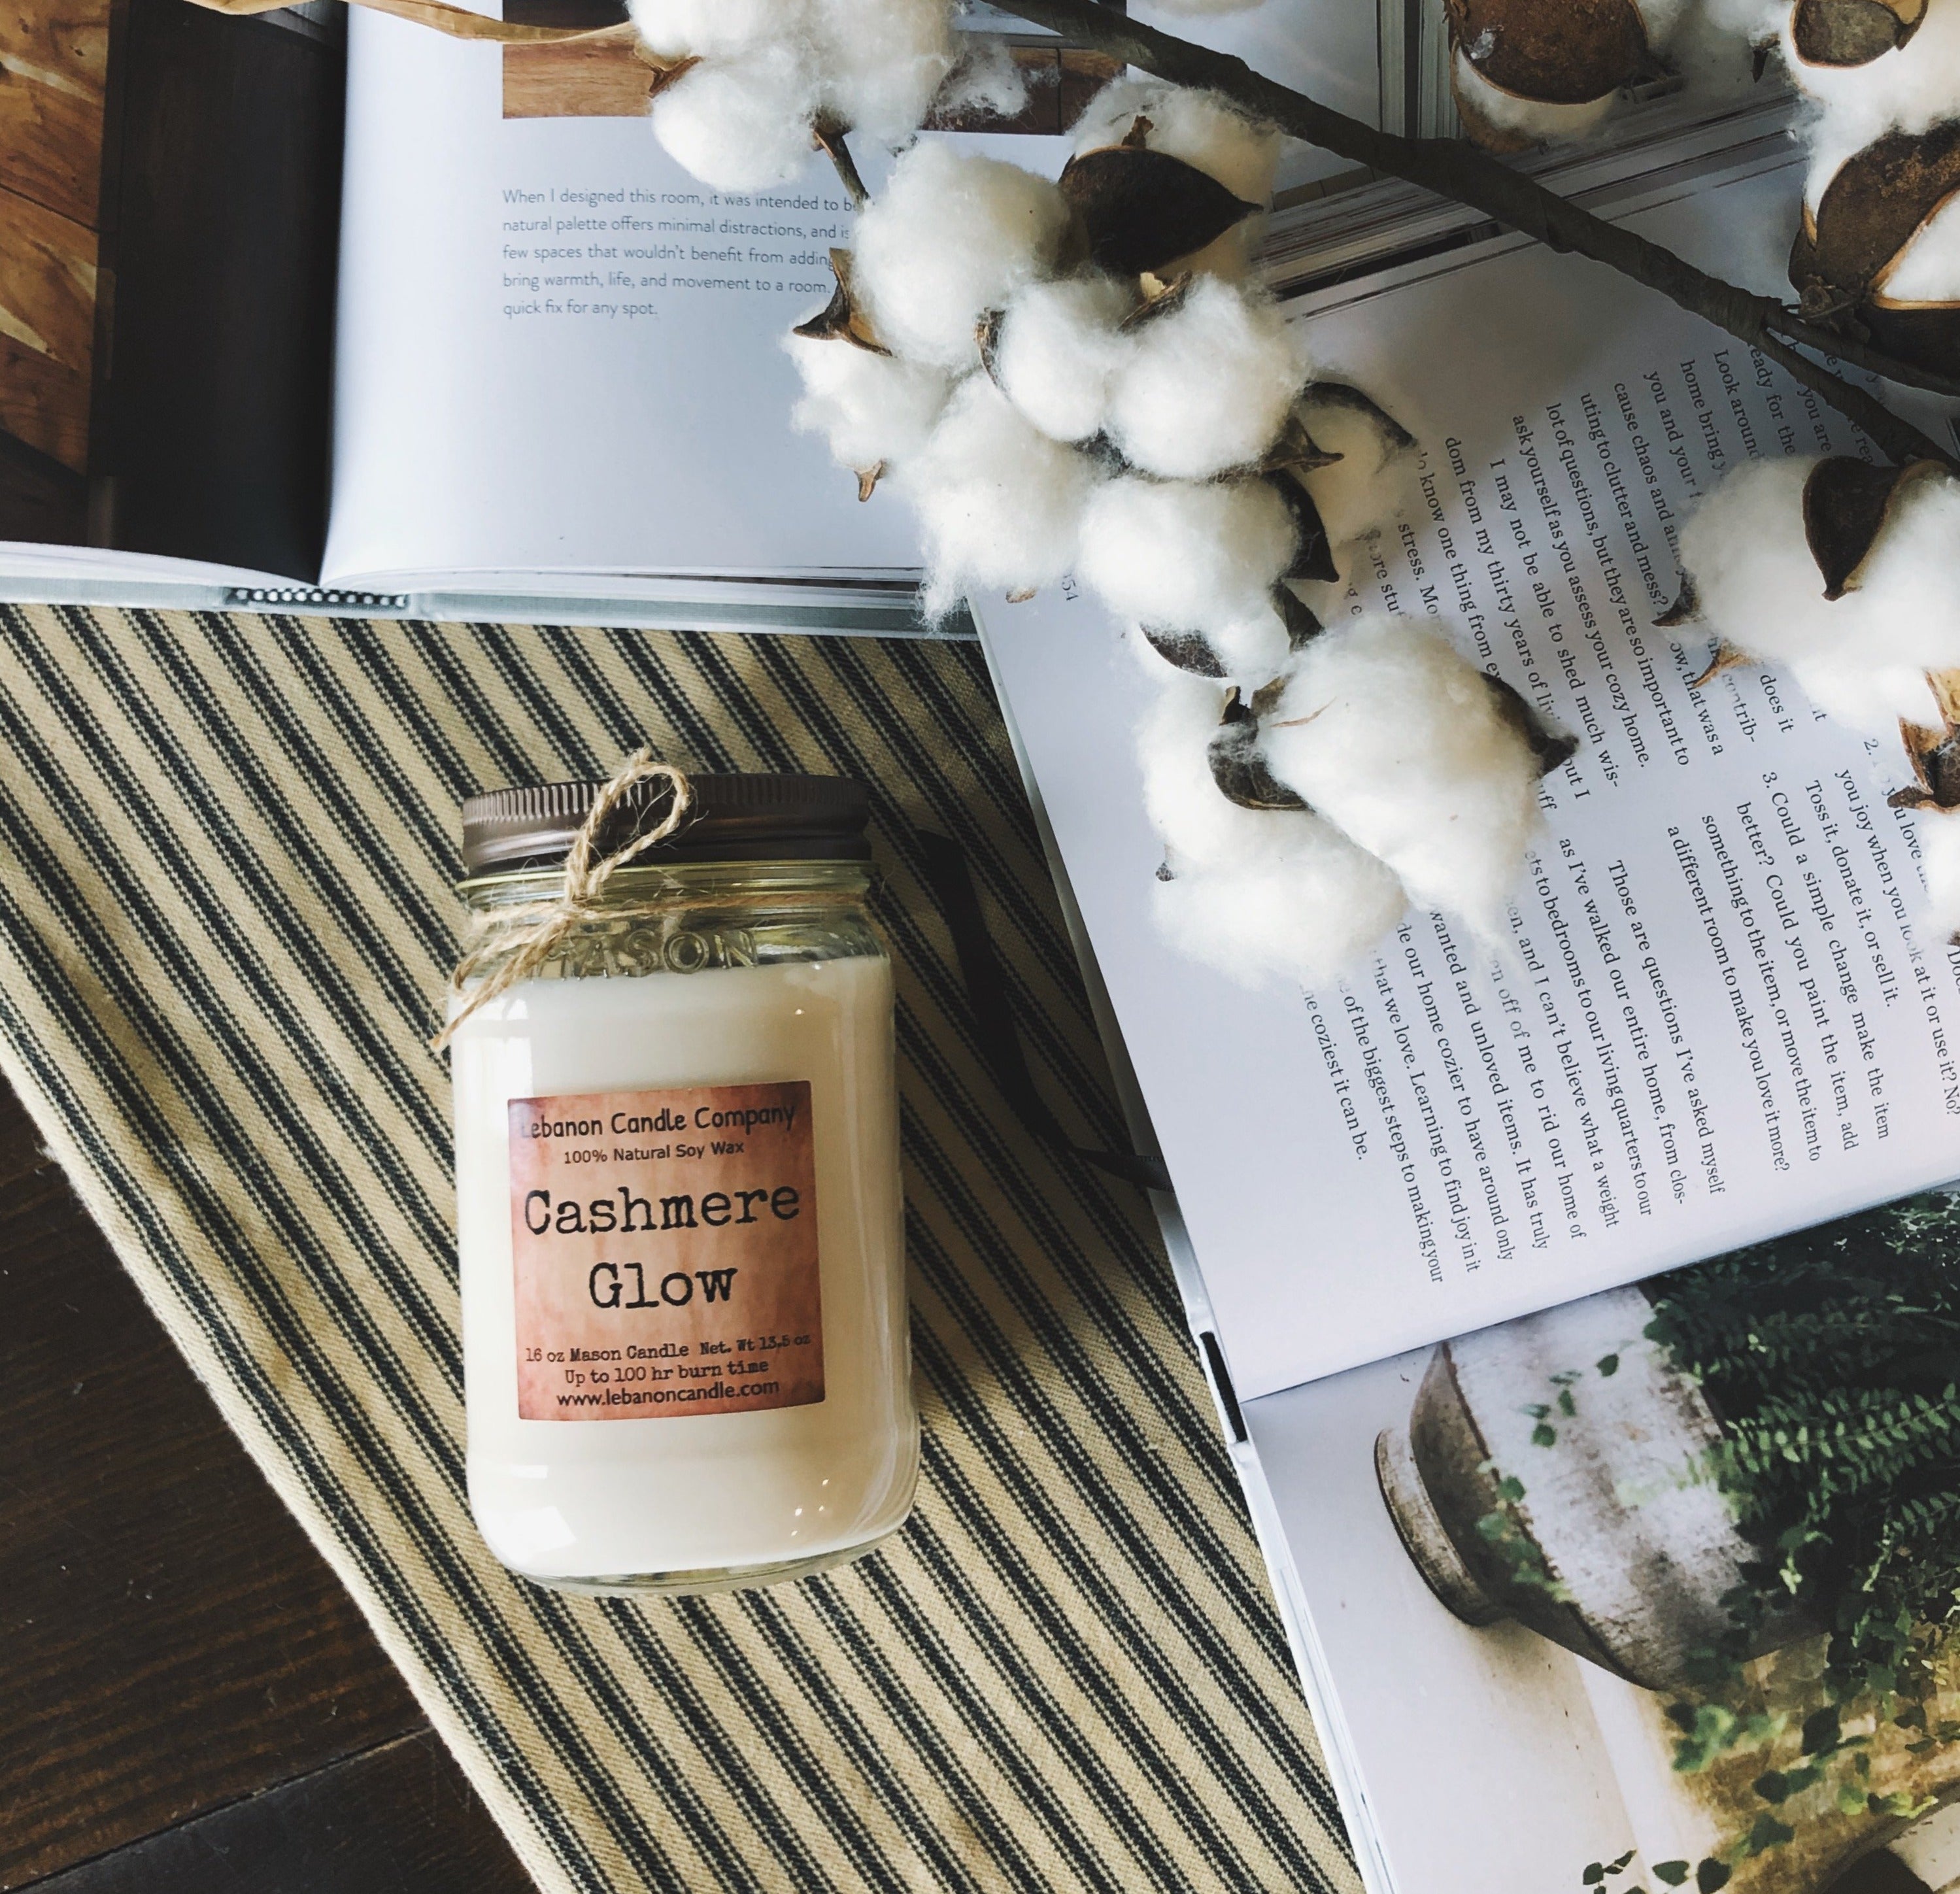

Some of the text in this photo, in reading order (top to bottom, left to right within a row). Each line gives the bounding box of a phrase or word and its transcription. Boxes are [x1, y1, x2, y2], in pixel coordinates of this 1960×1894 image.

[502, 189, 545, 203] When
[559, 188, 624, 208] designed
[629, 188, 656, 203] this
[661, 194, 705, 207] room,
[709, 194, 720, 205] it
[724, 196, 751, 207] was
[755, 194, 819, 210] intended
[823, 199, 839, 211] to
[502, 244, 528, 260] few
[533, 248, 583, 263] spaces
[587, 243, 618, 258] that
[623, 244, 685, 260] wouldn't
[690, 245, 743, 262] benefit
[748, 246, 784, 263] from
[503, 216, 552, 231] natural
[556, 215, 607, 235] palette
[611, 215, 654, 231] offers
[658, 217, 715, 233] minimal
[718, 218, 807, 239] distractions,
[810, 224, 837, 239] and
[503, 271, 830, 294] bring warmth, life, and movement to a room.
[503, 298, 658, 320] quick fix for any spot.
[1614, 382, 1675, 522] cause chaos and
[1642, 371, 1696, 486] you and your
[1680, 359, 1725, 460] home bring
[1489, 458, 1619, 787] I may not be able to shed much wis-
[1512, 415, 1649, 768] ask yourself as you assess your cozy home.
[1805, 779, 1898, 1007] Toss it, donate it, or sell it.
[1667, 826, 1789, 1170] a different room to make you love it more?
[1736, 801, 1859, 1150] better? Could you paint the item, add
[1762, 771, 1889, 1139] 3. Could a simple change make the item
[1559, 838, 1687, 1204] as I've walked our entire home, from clos-
[1608, 859, 1725, 1194] Those are questions I've asked myself
[610, 1108, 687, 1135] Candle
[694, 1106, 796, 1135] Company
[1311, 1014, 1367, 1160] coziest it can be.
[1343, 996, 1443, 1282] of the biggest steps to making your
[1455, 980, 1550, 1248] and unloved items. It has truly
[564, 1141, 744, 1164] 100% Natural Soy Wax
[524, 1185, 800, 1236] Cashmere
[588, 1262, 738, 1309] Glow
[526, 1347, 543, 1362] 16
[547, 1351, 566, 1362] oz
[569, 1347, 622, 1362] Mason
[626, 1343, 689, 1359] Candle
[699, 1341, 732, 1355] Net.
[736, 1338, 754, 1351] Wt
[794, 1334, 811, 1346] oz
[556, 1381, 779, 1407] www.lebanoncandle.com
[564, 1360, 768, 1388] Up to 100 hr burn time
